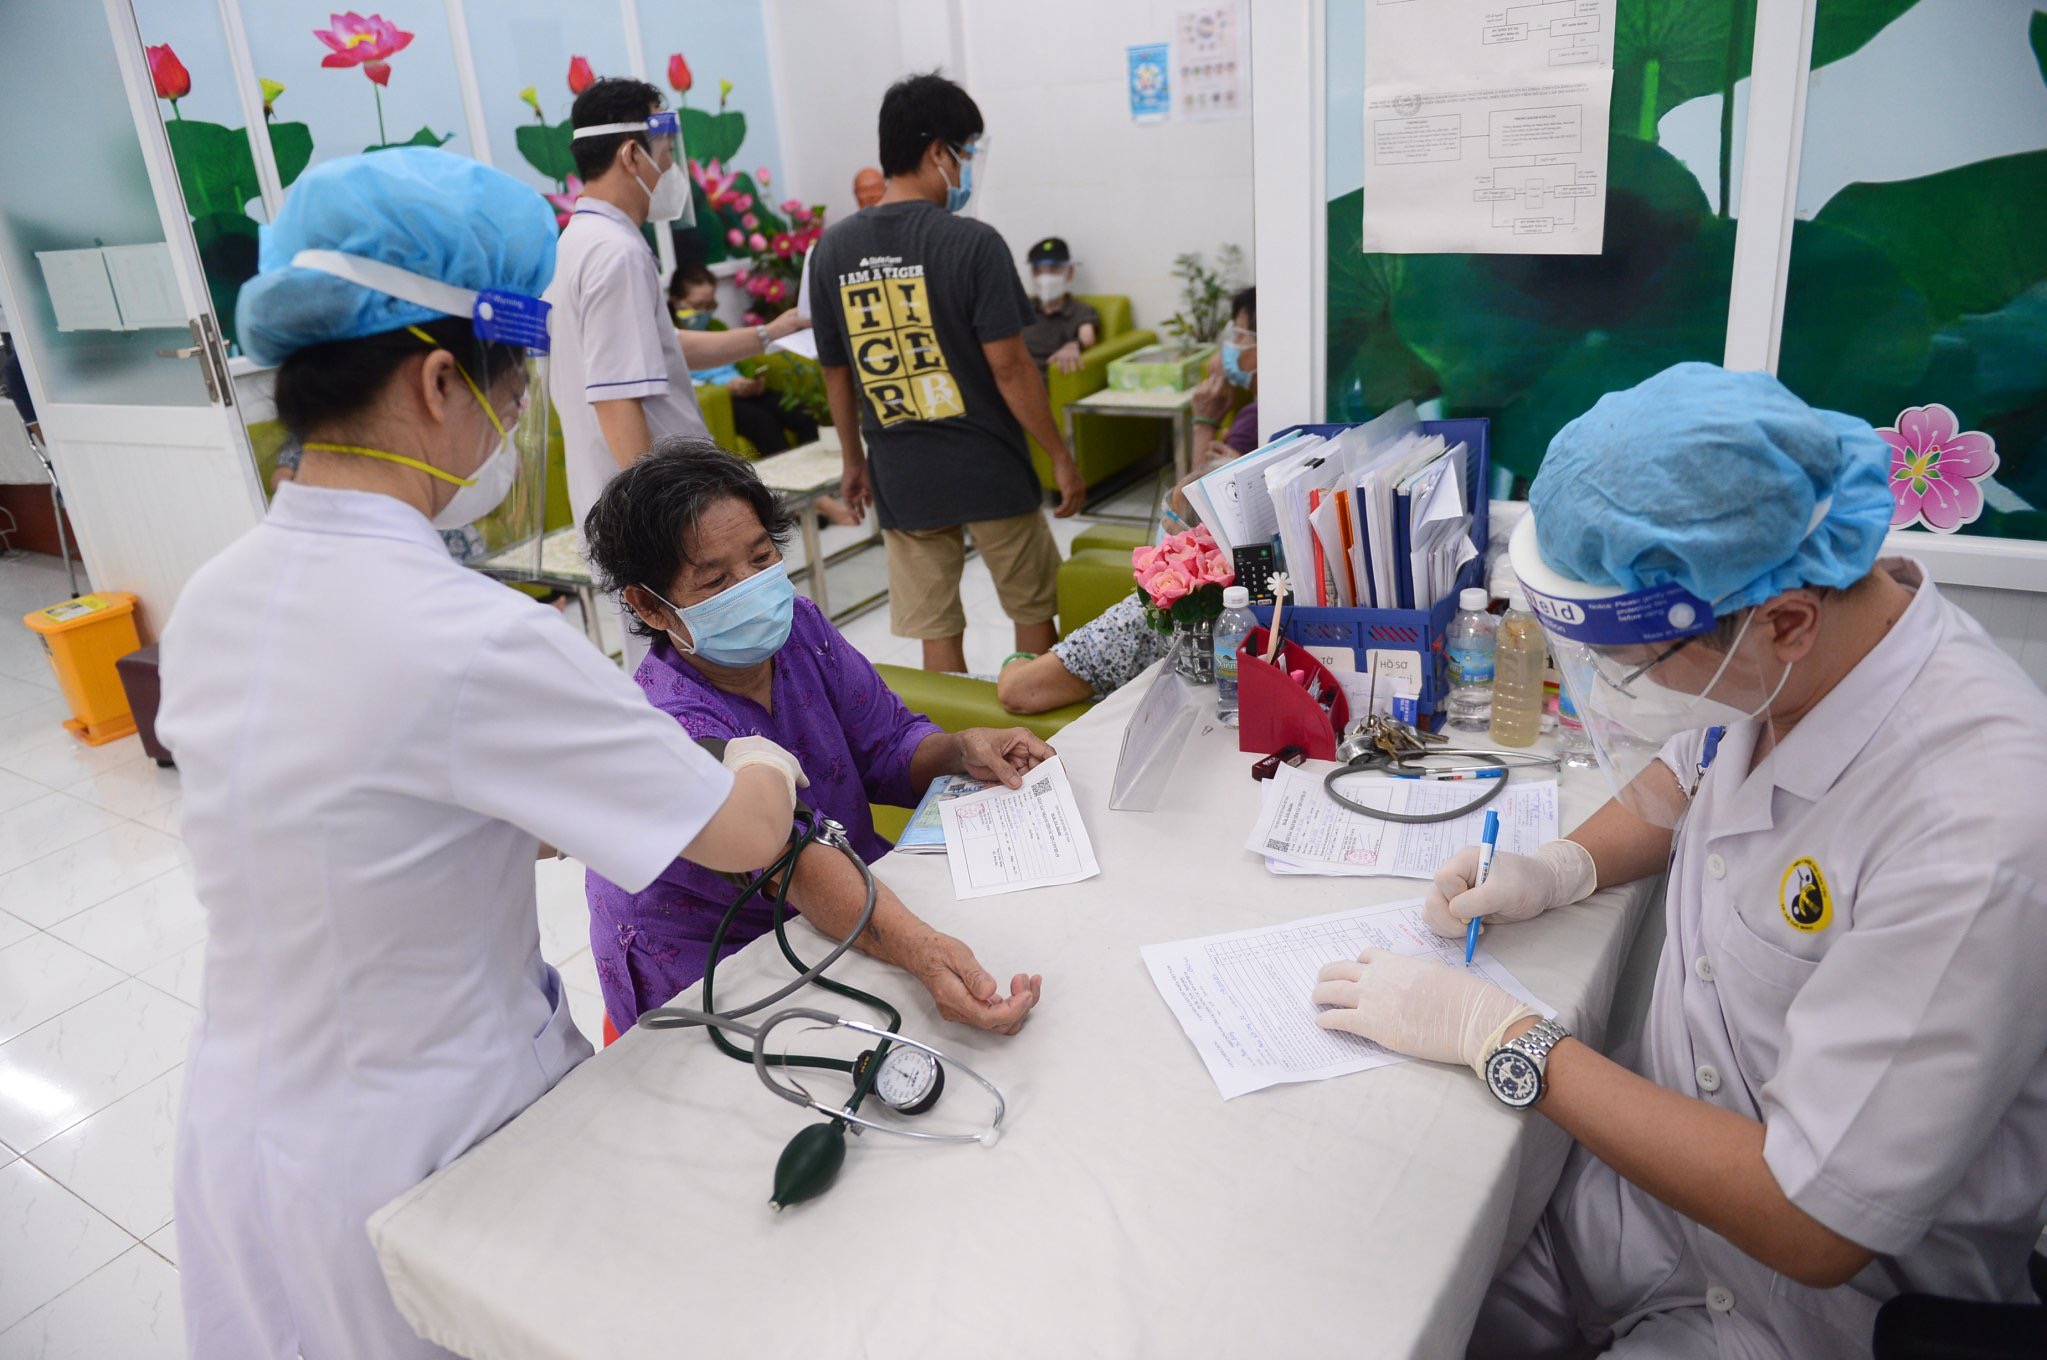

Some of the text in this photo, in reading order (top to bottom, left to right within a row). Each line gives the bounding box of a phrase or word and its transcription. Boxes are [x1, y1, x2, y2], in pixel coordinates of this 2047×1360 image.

[838, 264, 925, 286] I AM A TIGER
[848, 283, 921, 329] T I
[858, 336, 900, 377] G
[1320, 656, 1334, 665] TỜ
[1380, 658, 1408, 670] HỒ SƠ
